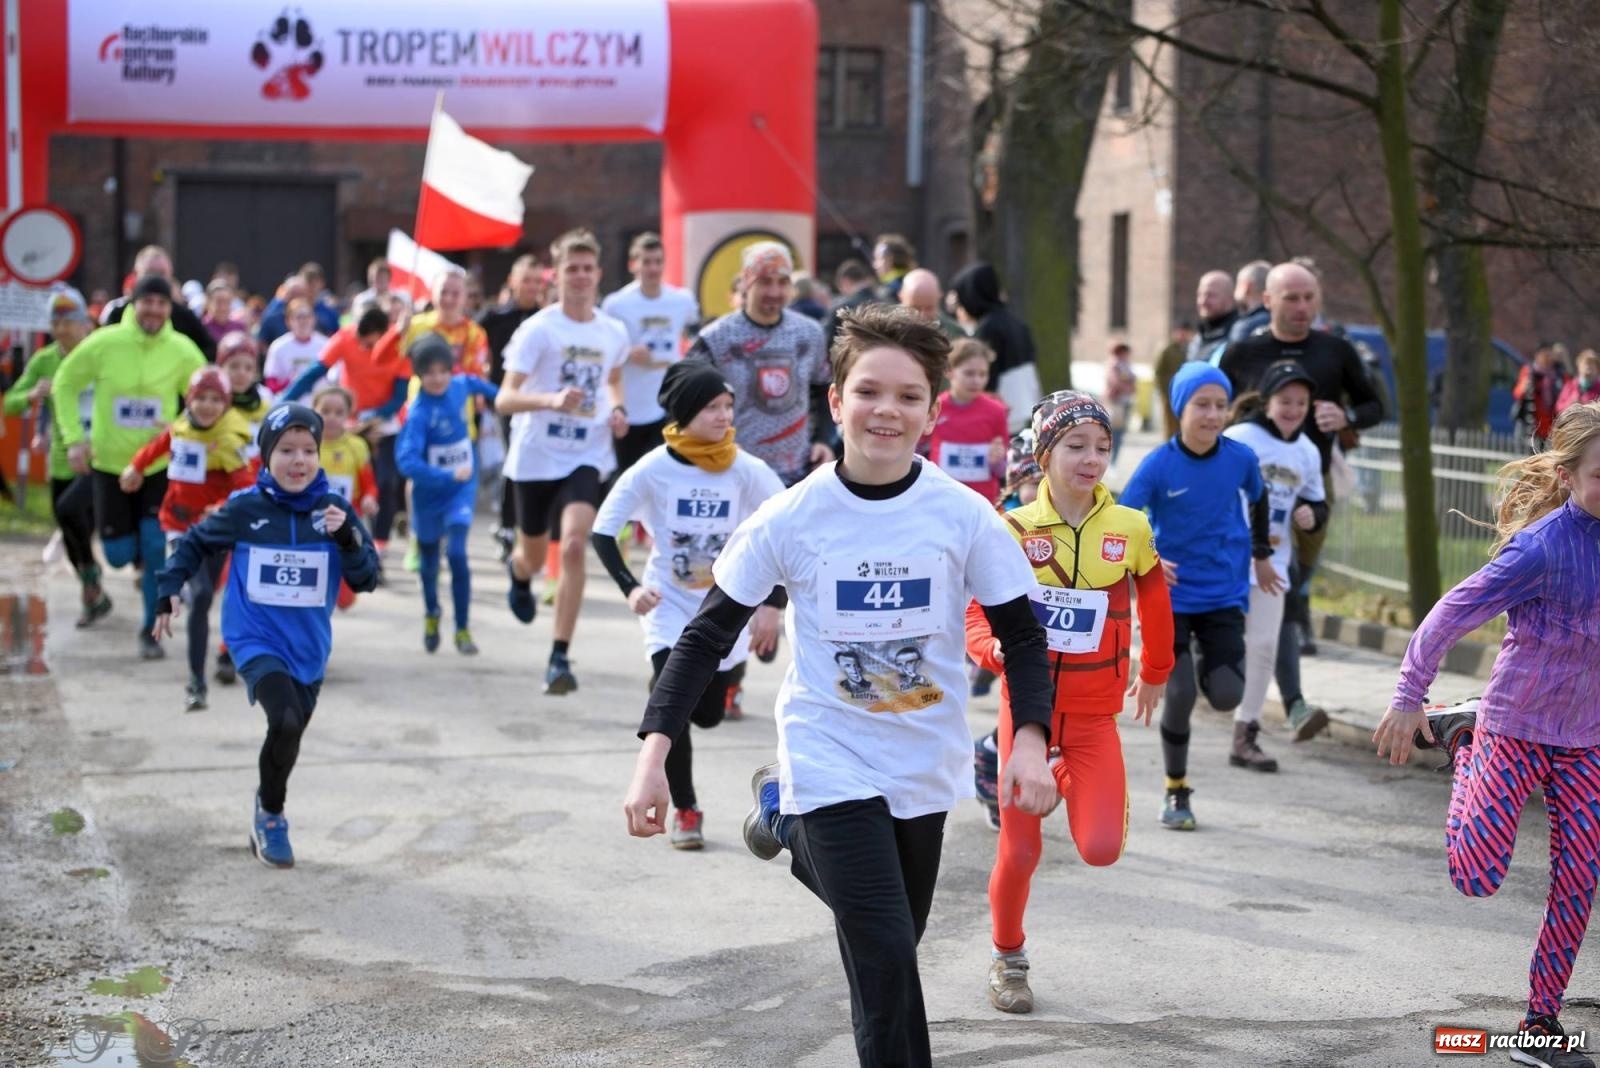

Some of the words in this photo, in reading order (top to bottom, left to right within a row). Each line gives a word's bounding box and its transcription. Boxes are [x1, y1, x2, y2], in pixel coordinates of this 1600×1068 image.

[688, 500, 722, 517] 137
[275, 567, 301, 585] 63
[874, 567, 909, 576] WILCZYM
[864, 582, 904, 609] 44
[1045, 606, 1075, 630] 70
